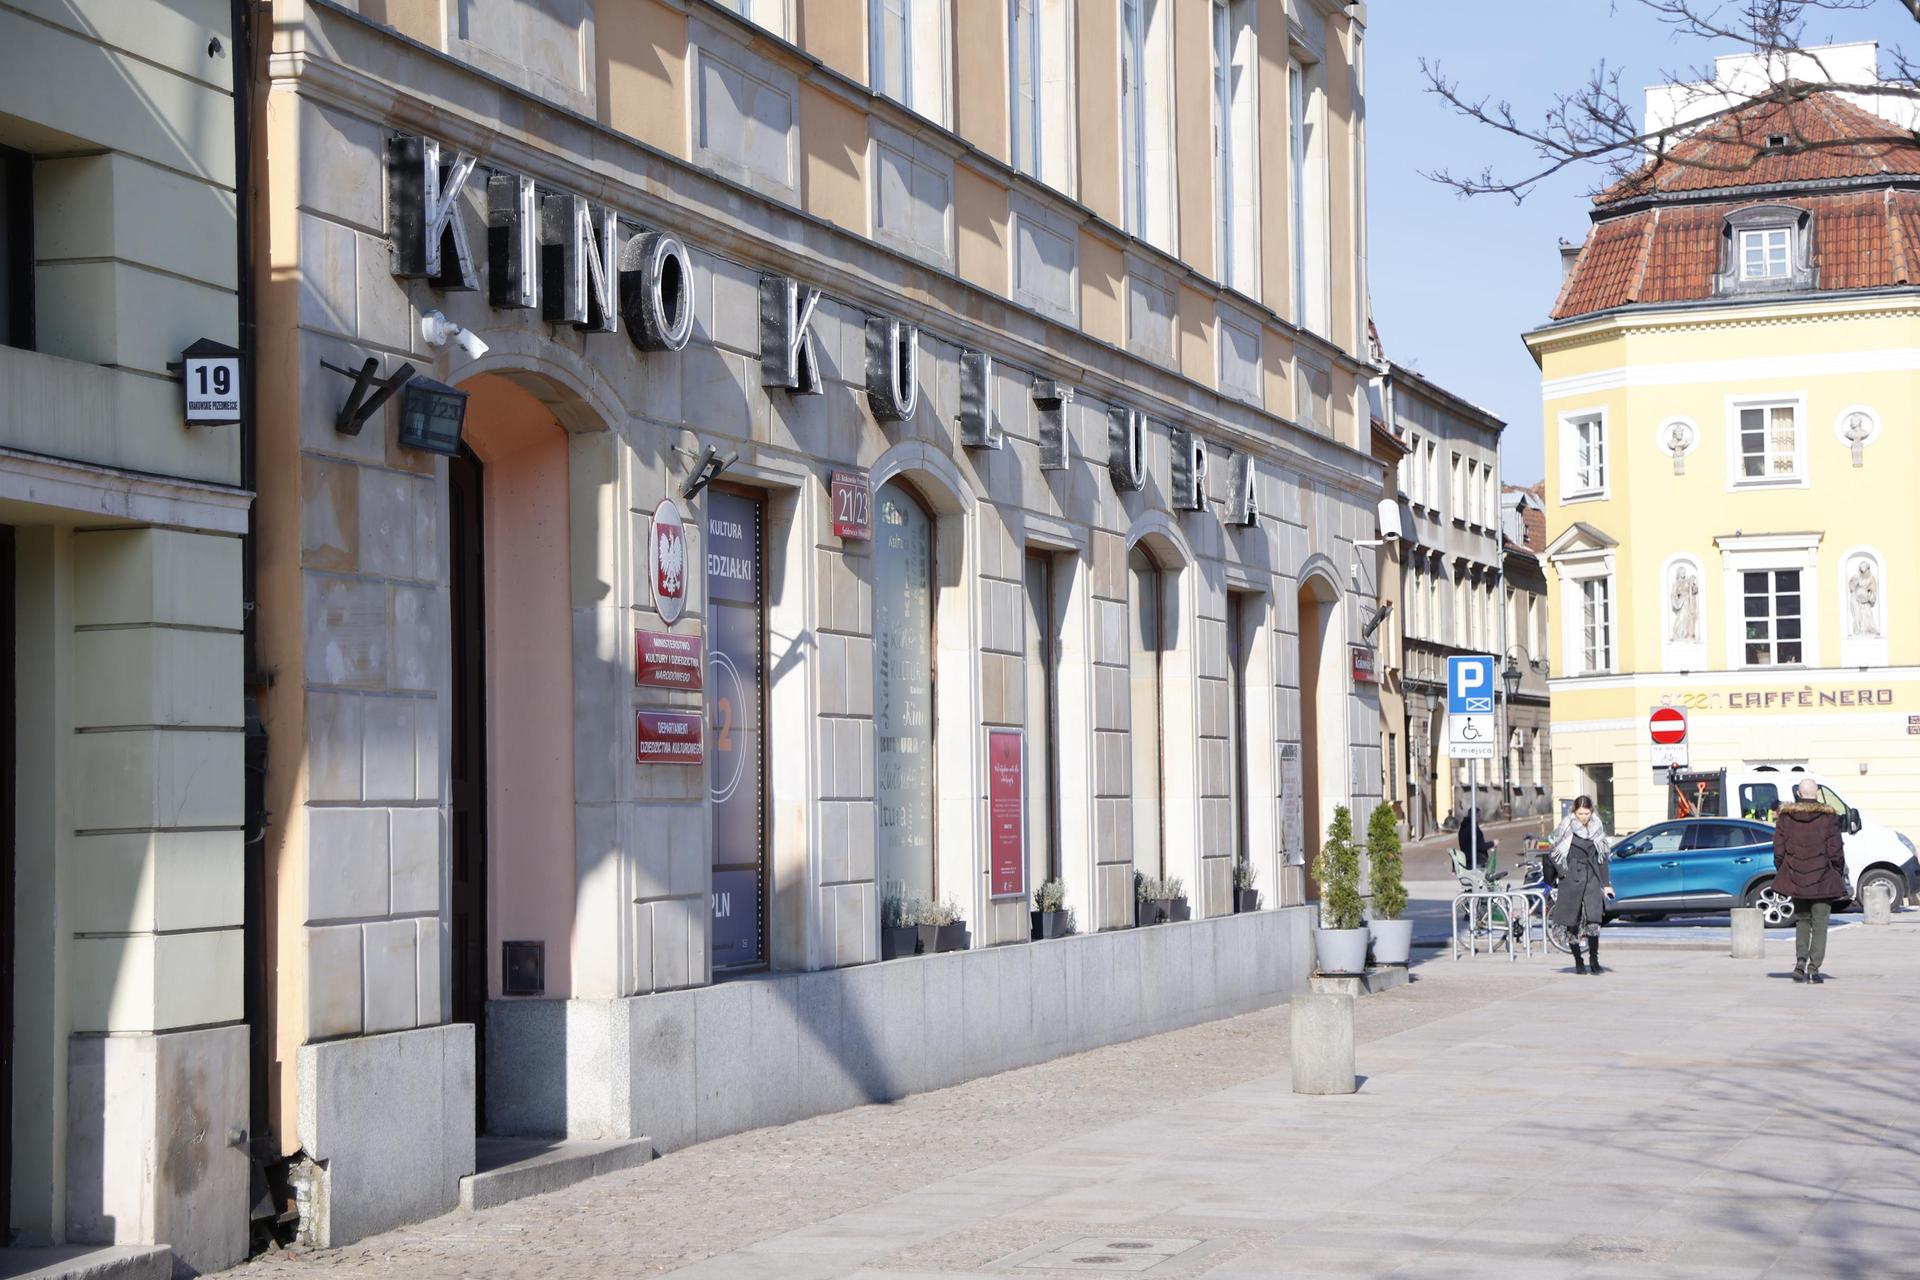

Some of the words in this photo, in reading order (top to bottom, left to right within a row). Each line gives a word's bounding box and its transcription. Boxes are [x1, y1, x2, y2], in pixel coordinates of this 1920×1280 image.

[388, 135, 695, 352] KINO
[195, 366, 230, 395] 19
[760, 277, 1260, 530] KULTURA
[839, 489, 868, 525] 21/23
[709, 519, 743, 539] KULTURA
[654, 638, 691, 650] MINISTERSTWO
[645, 653, 668, 664] KULTURY
[655, 670, 691, 682] NARODOWEGO
[1728, 685, 1813, 708] CAFFÈ
[1818, 688, 1893, 707] NERO
[657, 721, 689, 735] DEPARTAMENT
[640, 741, 671, 753] DZIEDZICTWA
